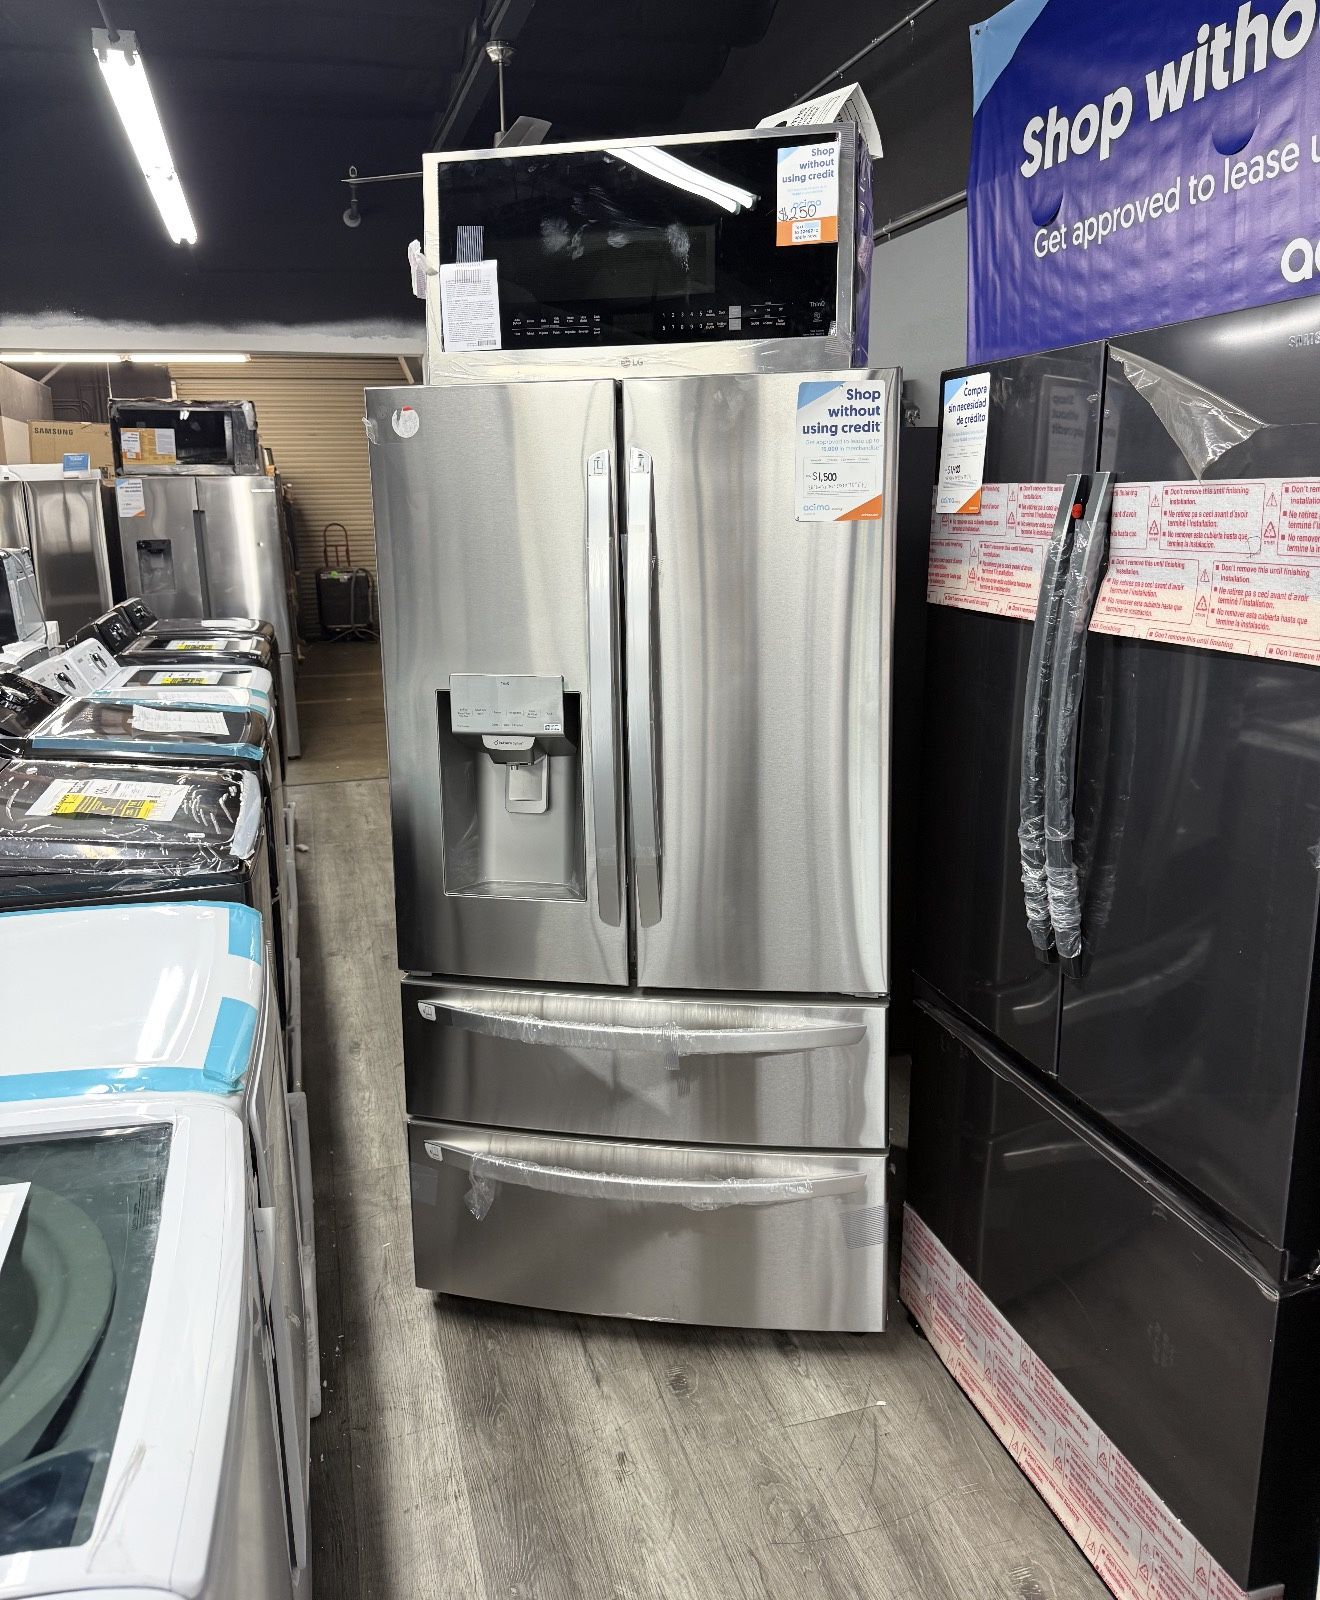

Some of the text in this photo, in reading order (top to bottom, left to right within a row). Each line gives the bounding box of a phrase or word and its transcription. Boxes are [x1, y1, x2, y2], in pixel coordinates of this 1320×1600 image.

[1021, 0, 1320, 178] Shop witho
[812, 148, 834, 156] Shop
[800, 159, 834, 169] without
[782, 170, 834, 183] using credit
[1034, 226, 1066, 258] Get
[1072, 178, 1180, 249] approved
[1189, 172, 1215, 205] to
[1224, 143, 1299, 194] lease
[1281, 238, 1320, 283] a
[846, 388, 881, 402] Shop
[964, 385, 987, 398] Compra
[828, 405, 880, 417] without
[948, 398, 987, 413] sin necesidad
[957, 413, 986, 425] de crédito
[803, 421, 880, 436] using credit
[812, 472, 837, 482] $1,500
[1289, 510, 1297, 518] Ne
[1284, 568, 1310, 578] finishing
[1276, 648, 1291, 656] Don't
